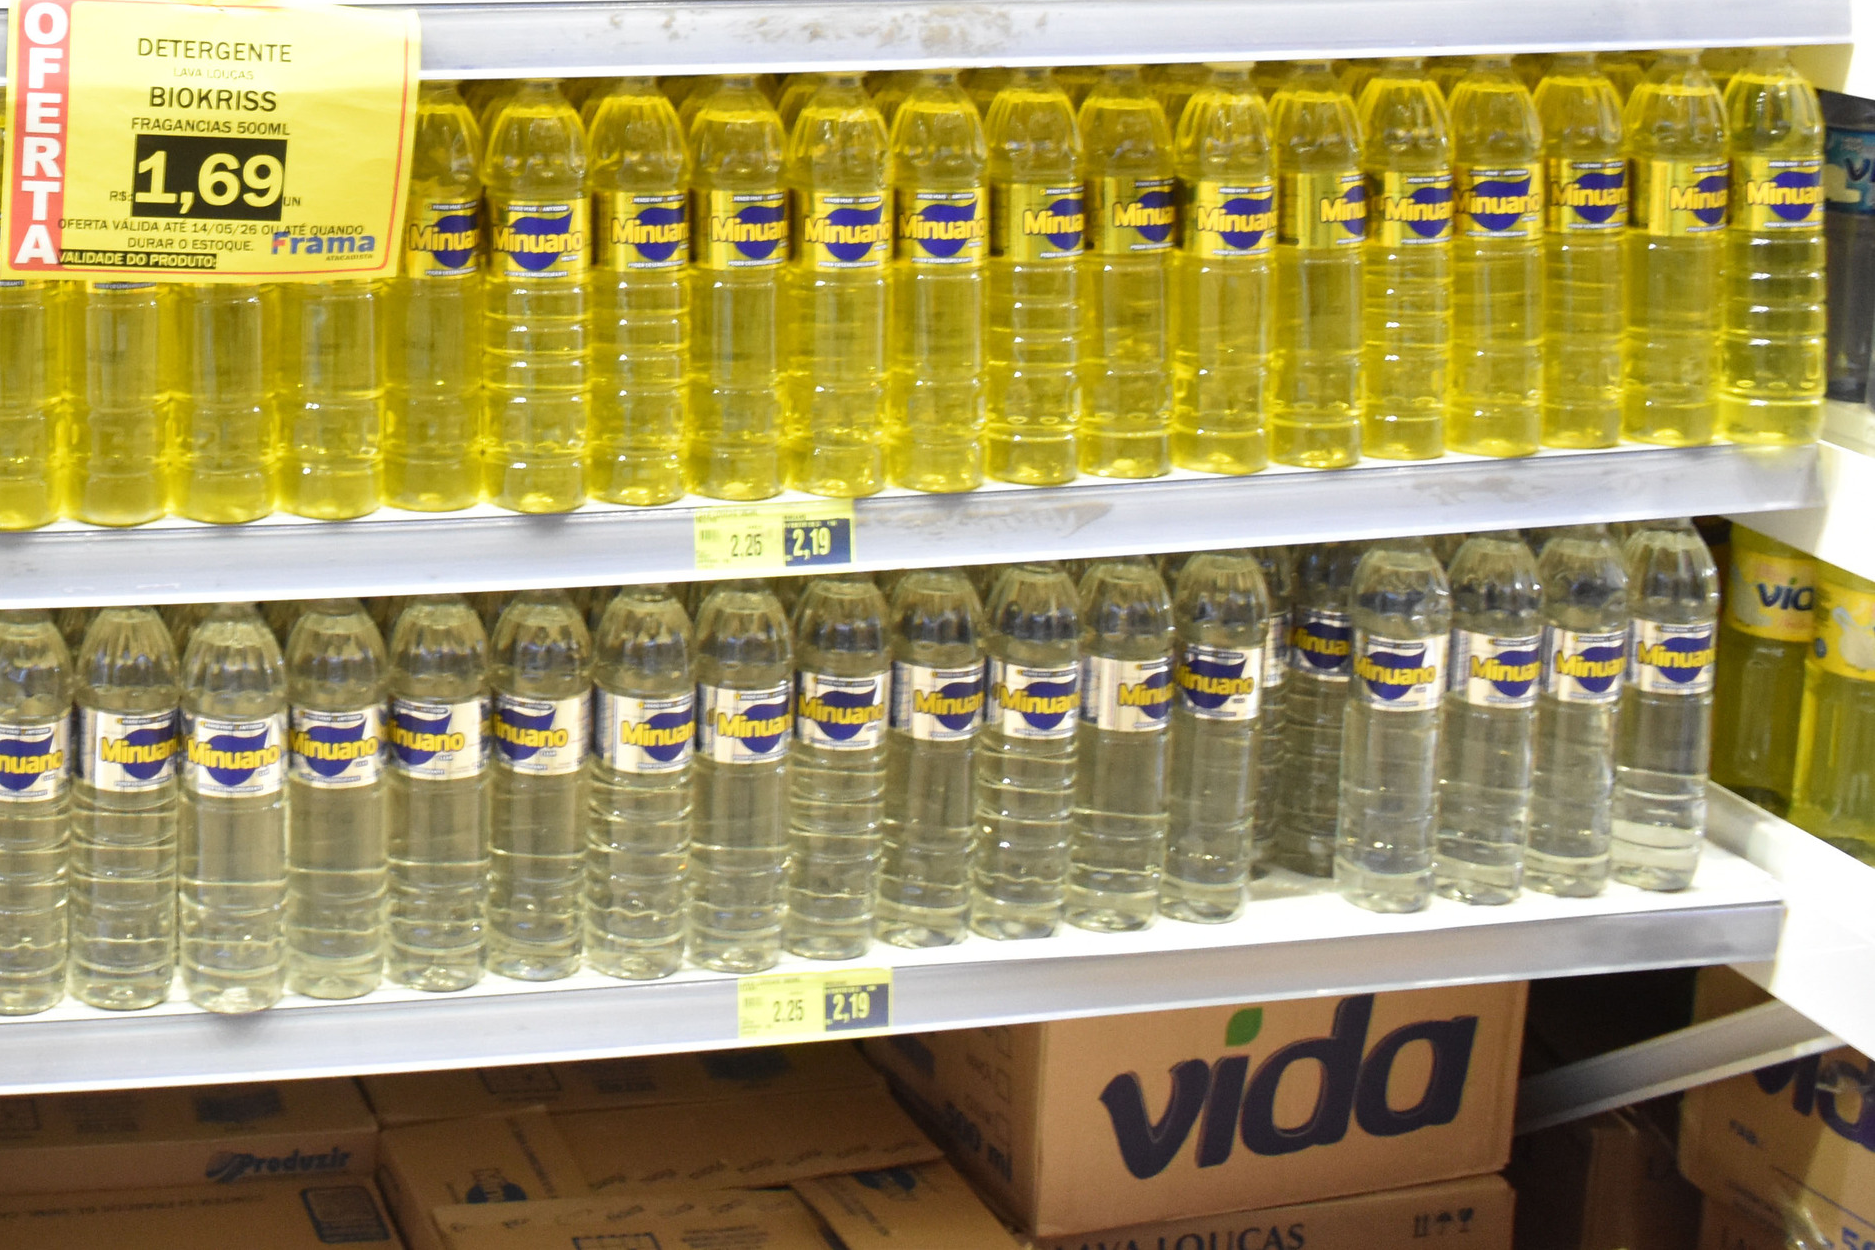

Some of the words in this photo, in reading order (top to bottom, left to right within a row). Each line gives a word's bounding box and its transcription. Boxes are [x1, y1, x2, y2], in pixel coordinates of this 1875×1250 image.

[137, 37, 292, 63] DETERGENTE
[173, 68, 202, 79] LAVA
[149, 86, 278, 113] BIOKRISS
[15, 2, 69, 265] OFERTA
[131, 117, 232, 134] FRAGANCIAS
[236, 121, 291, 136] 500ML
[135, 150, 284, 214] 1,69
[283, 196, 301, 207] UN
[58, 219, 108, 231] OFERTA
[112, 219, 159, 233] VÁLIDA
[163, 220, 187, 234] ATÉ
[191, 222, 258, 235] 14/05/26
[261, 224, 279, 236] OU
[281, 223, 306, 236] ATÉ
[310, 224, 364, 236] QUANDO
[493, 225, 583, 254] Minuano
[899, 212, 985, 241] Minuano
[127, 237, 174, 250] DURAR
[178, 238, 188, 250] O
[192, 238, 254, 252] ESTOQUE.
[59, 251, 126, 266] VALIDADE
[126, 253, 147, 267] DO
[150, 254, 216, 268] PRODUTO:
[792, 526, 832, 561] 2,19
[187, 736, 279, 770] Minuano
[290, 728, 379, 761] Minuano
[833, 991, 871, 1024] 2,19
[1099, 992, 1479, 1180] vida
